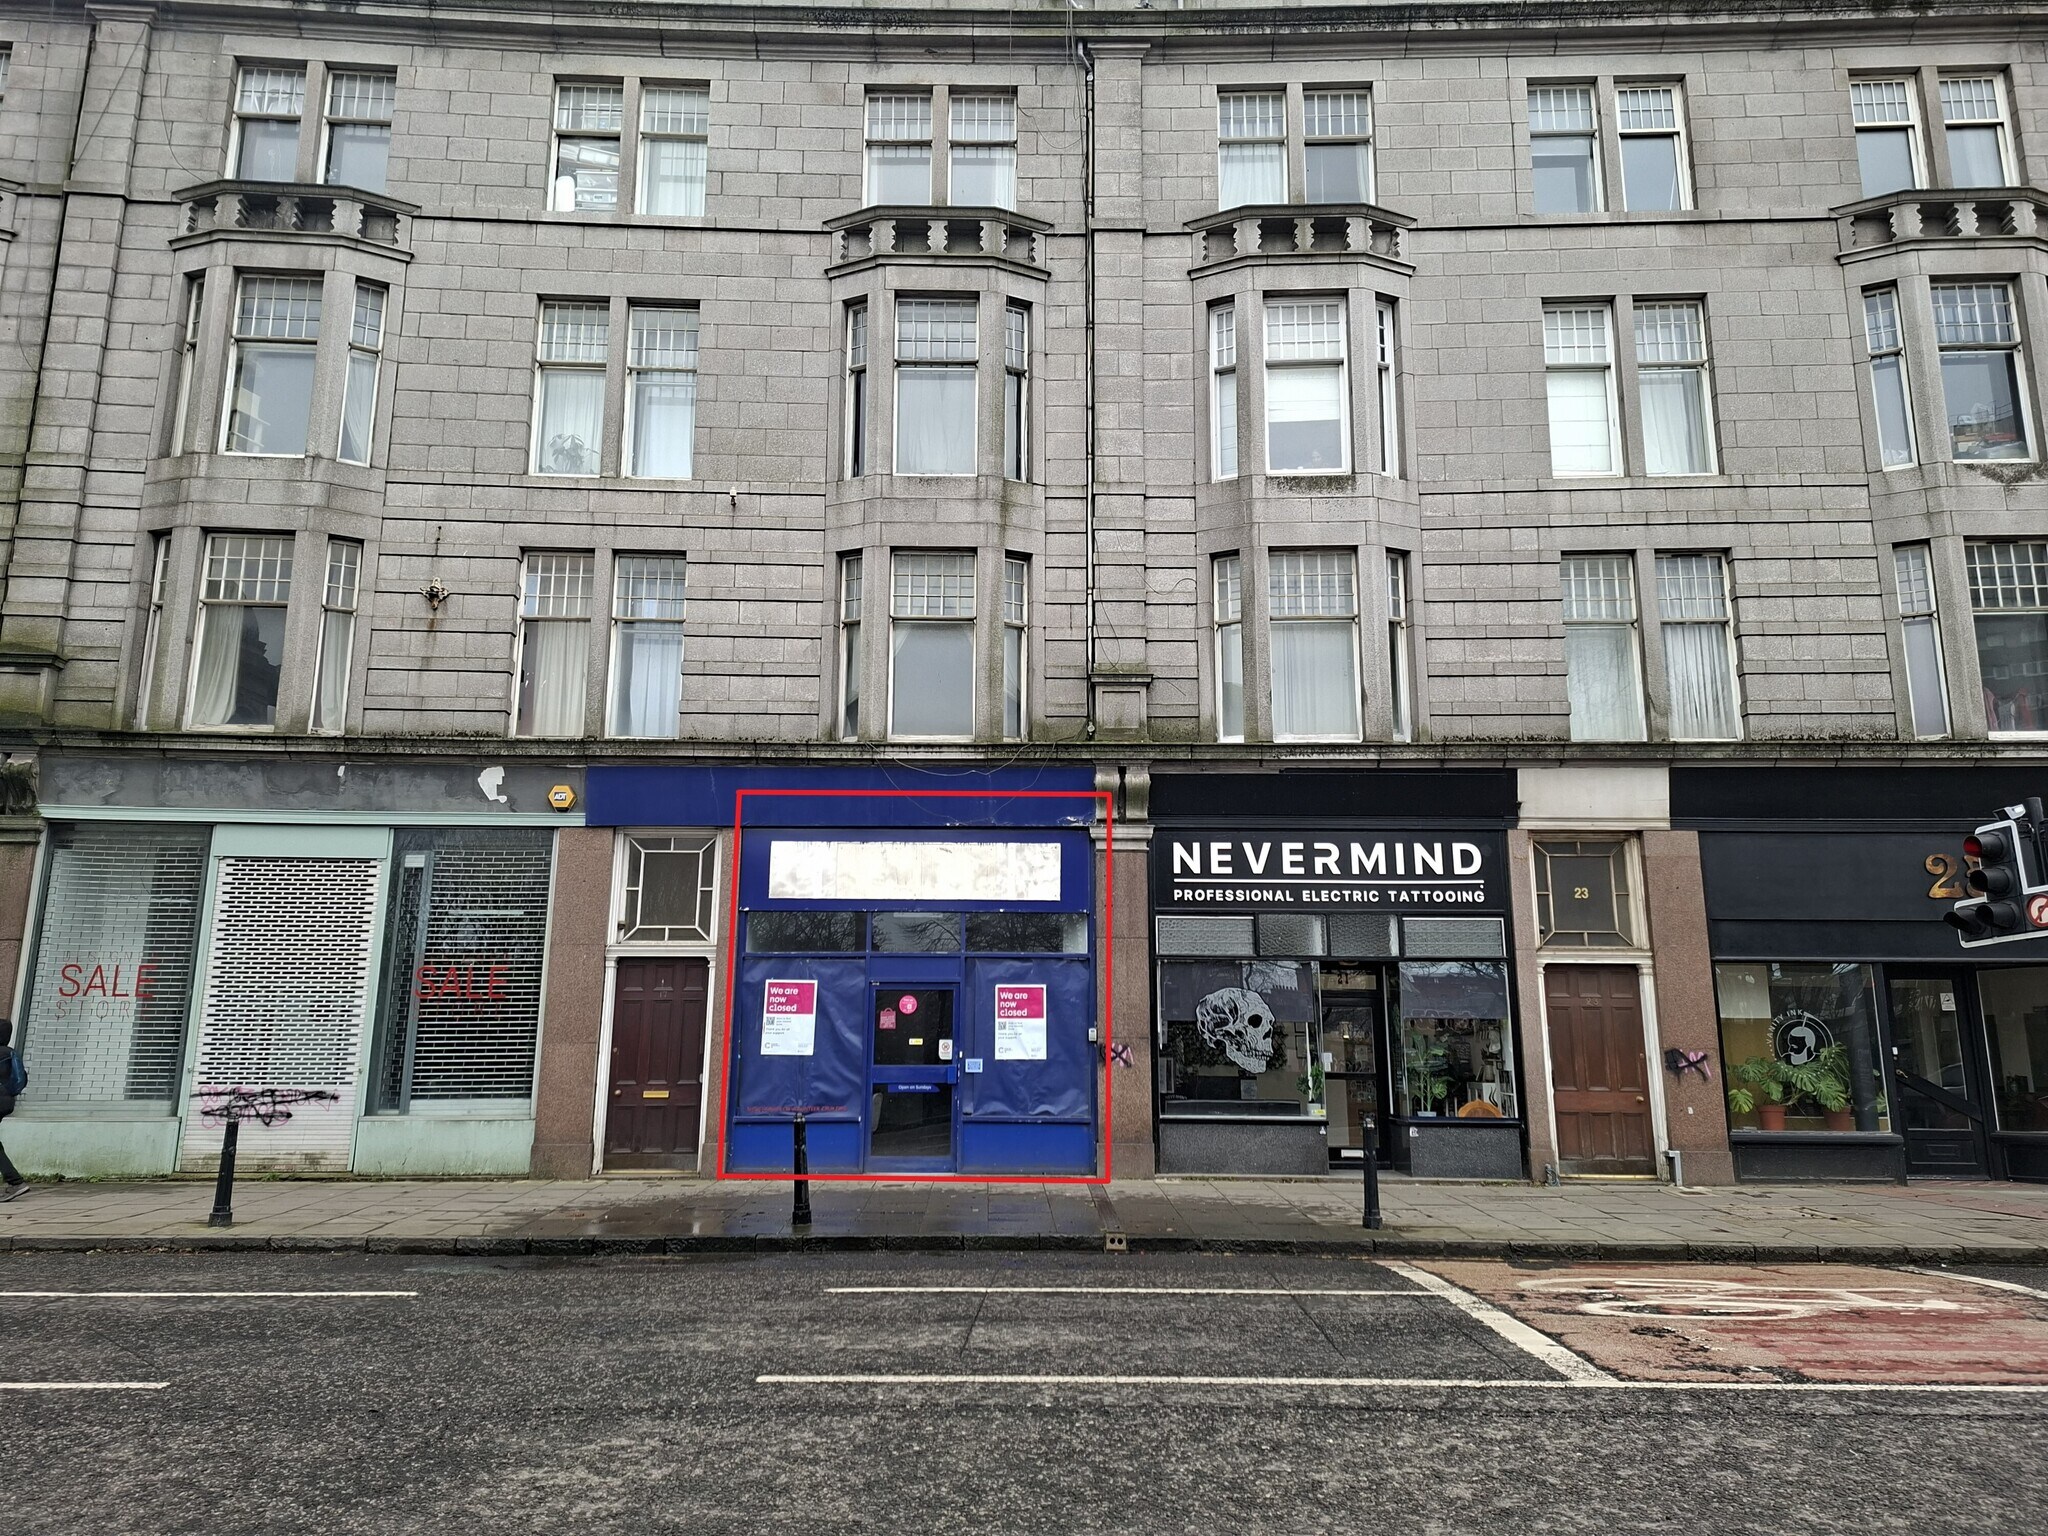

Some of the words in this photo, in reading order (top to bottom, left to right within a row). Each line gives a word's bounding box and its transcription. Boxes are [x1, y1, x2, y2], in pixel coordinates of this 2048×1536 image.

[554, 792, 567, 800] ADT
[1172, 842, 1483, 875] NEVERMIND
[1173, 889, 1294, 902] PROFESSIONAL
[1302, 890, 1380, 902] ELECTRIC
[1389, 890, 1485, 903] TATTOOING
[1574, 887, 1589, 899] 23
[59, 963, 159, 997] SALE
[415, 965, 509, 999] SALE
[770, 987, 783, 995] We
[1000, 992, 1013, 1000] We
[768, 1003, 797, 1012] closed
[1000, 1008, 1028, 1017] closed
[1766, 1014, 1784, 1044] VANITY
[1786, 1009, 1803, 1017] INK
